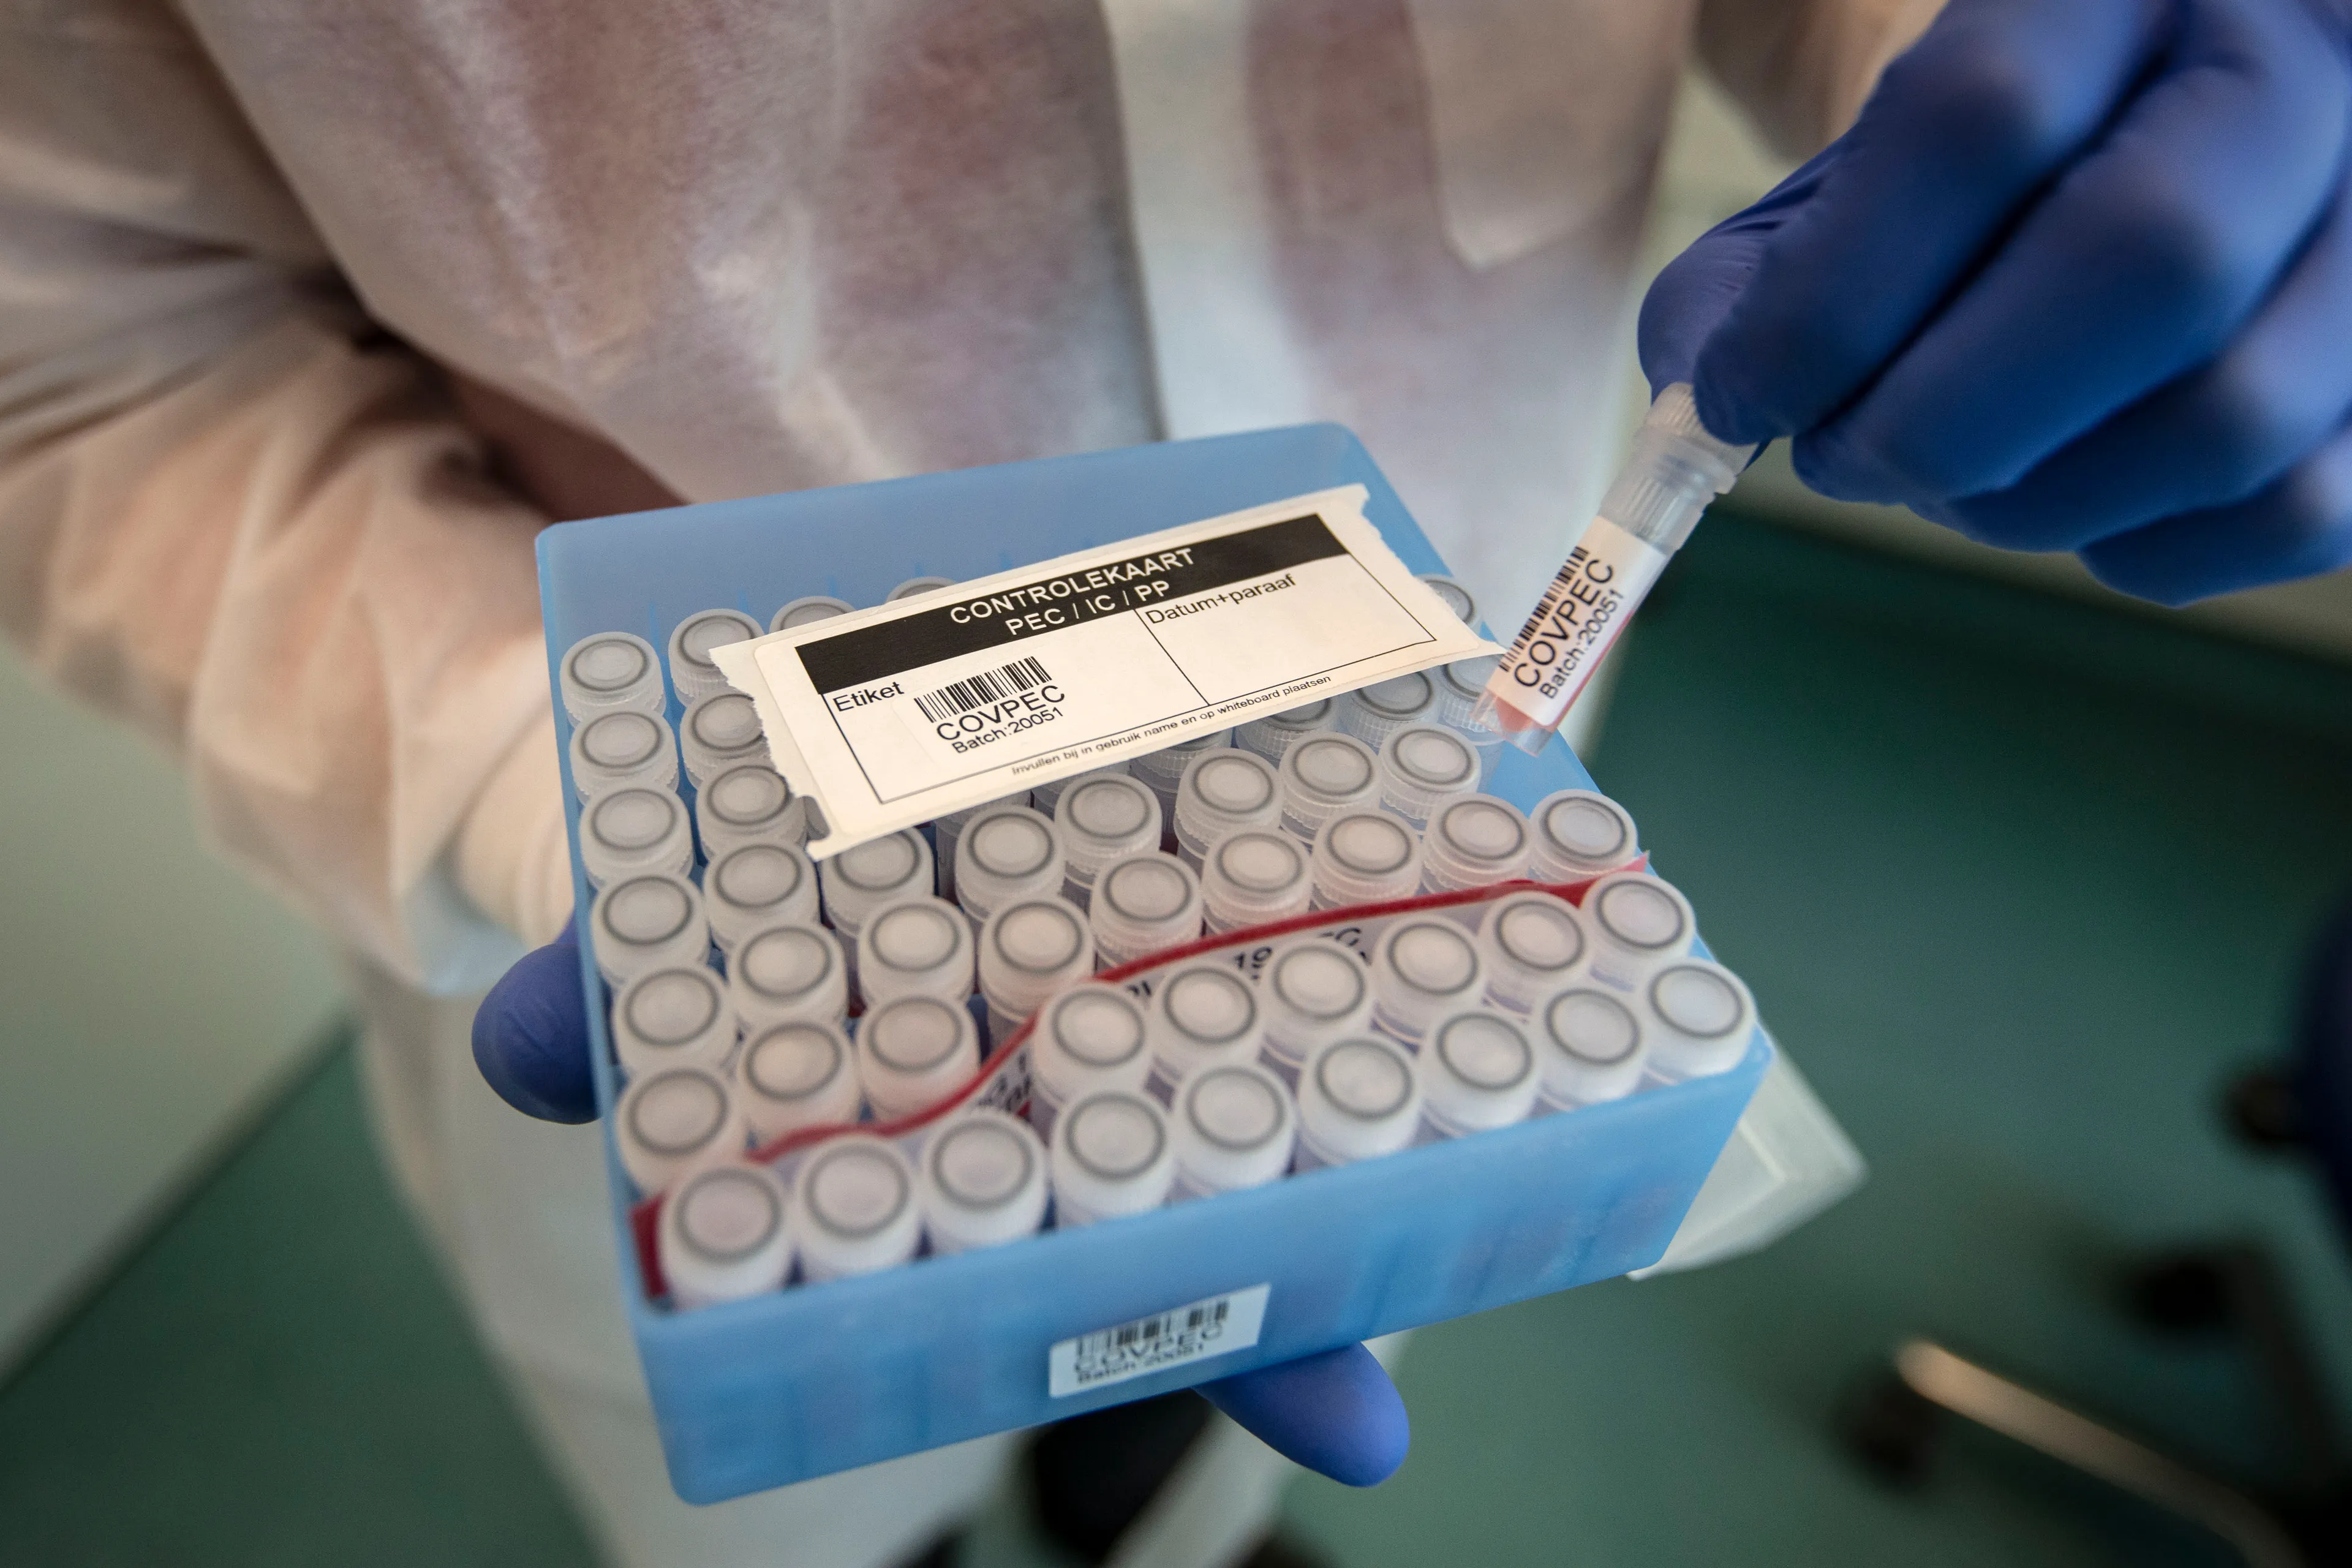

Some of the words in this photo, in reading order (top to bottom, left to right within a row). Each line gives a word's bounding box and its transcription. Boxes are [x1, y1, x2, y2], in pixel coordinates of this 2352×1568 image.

[950, 548, 1195, 624] CONTROLEKAART
[1005, 608, 1065, 635] PEC
[1072, 603, 1080, 619] /
[1085, 595, 1116, 614] IC
[1122, 590, 1130, 606] /
[1134, 580, 1170, 603] PP
[1145, 573, 1296, 624] Datum+paraaf
[1513, 559, 1613, 688] COVPEC
[1539, 589, 1624, 699] Batch:20051
[832, 681, 905, 712] Etiket
[936, 685, 1065, 741] COVPEC
[1063, 748, 1079, 760] bij
[1081, 746, 1093, 755] in
[1096, 731, 1141, 752] gebruik
[1144, 722, 1178, 737] name
[1181, 715, 1197, 726] en
[1199, 710, 1215, 720] op
[1217, 690, 1280, 715] whiteboard
[1283, 675, 1332, 696] plaatsen
[951, 707, 1064, 754] Batch:20051
